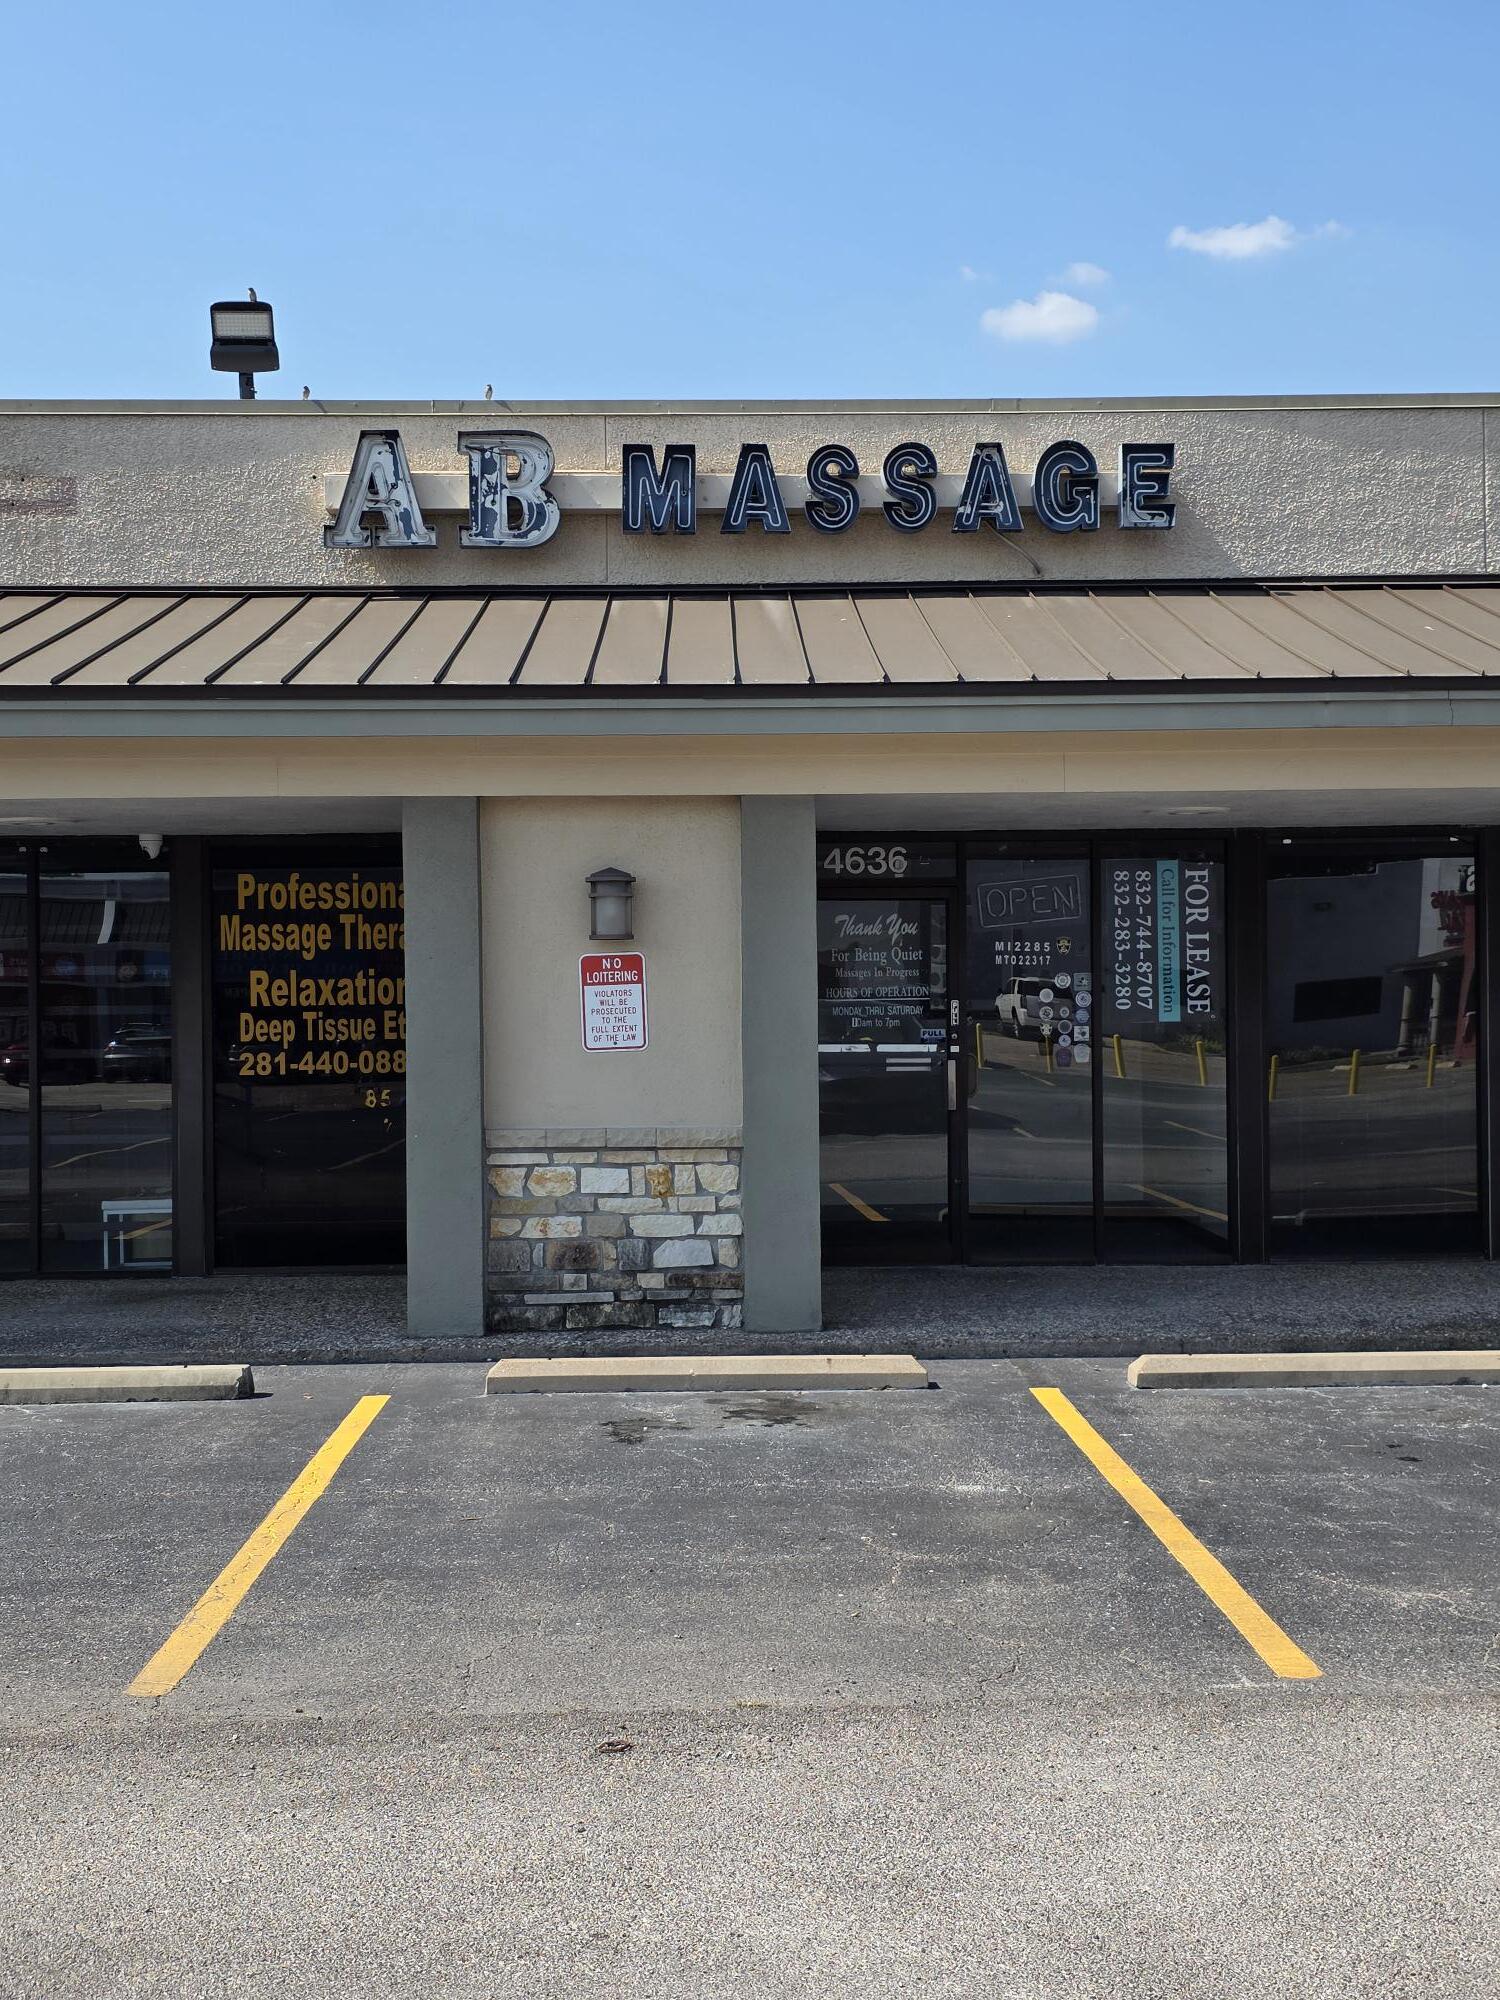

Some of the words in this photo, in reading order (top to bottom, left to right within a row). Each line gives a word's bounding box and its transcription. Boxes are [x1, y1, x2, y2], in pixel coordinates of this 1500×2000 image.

[621, 439, 1176, 535] MASSAGE
[823, 846, 908, 875] 4636
[1160, 868, 1175, 896] Call
[986, 884, 1075, 917] OPEN
[1185, 868, 1209, 925] FOR
[1161, 901, 1176, 922] for
[220, 914, 332, 961] Massage
[834, 914, 884, 938] Thank
[885, 913, 918, 946] You
[1113, 870, 1132, 1010] 832-283-3280
[1135, 870, 1153, 1010] 832-744-8707
[602, 957, 622, 969] NO
[831, 948, 850, 962] For
[855, 946, 887, 966] Being
[891, 946, 923, 965] Quiet
[586, 970, 638, 983] LOITERING
[835, 969, 872, 979] Massages
[874, 967, 883, 977] In
[886, 967, 920, 979] Progress
[1162, 926, 1177, 1013] Information
[1186, 931, 1211, 1014] LEASE
[594, 989, 633, 998] VIOLATORS
[618, 998, 628, 1006] BE
[826, 987, 858, 998] HOURS
[860, 986, 873, 997] OF
[875, 985, 930, 997] OPERATION
[591, 1006, 637, 1016] PROSECUTED
[601, 1016, 611, 1024] TO
[613, 1015, 628, 1024] THE
[832, 1006, 863, 1016] MONDAY
[865, 1006, 885, 1016] THRU
[887, 1004, 924, 1016] SATURDAY
[239, 1012, 296, 1050] Deep
[303, 1011, 376, 1042] Tissue
[591, 1025, 609, 1034] FULL
[612, 1024, 638, 1033] EXTENT
[875, 1018, 883, 1027] to
[593, 1034, 603, 1043] OF
[605, 1033, 619, 1042] THE
[622, 1033, 637, 1041] LAW
[239, 1050, 406, 1077] 281-440-088
